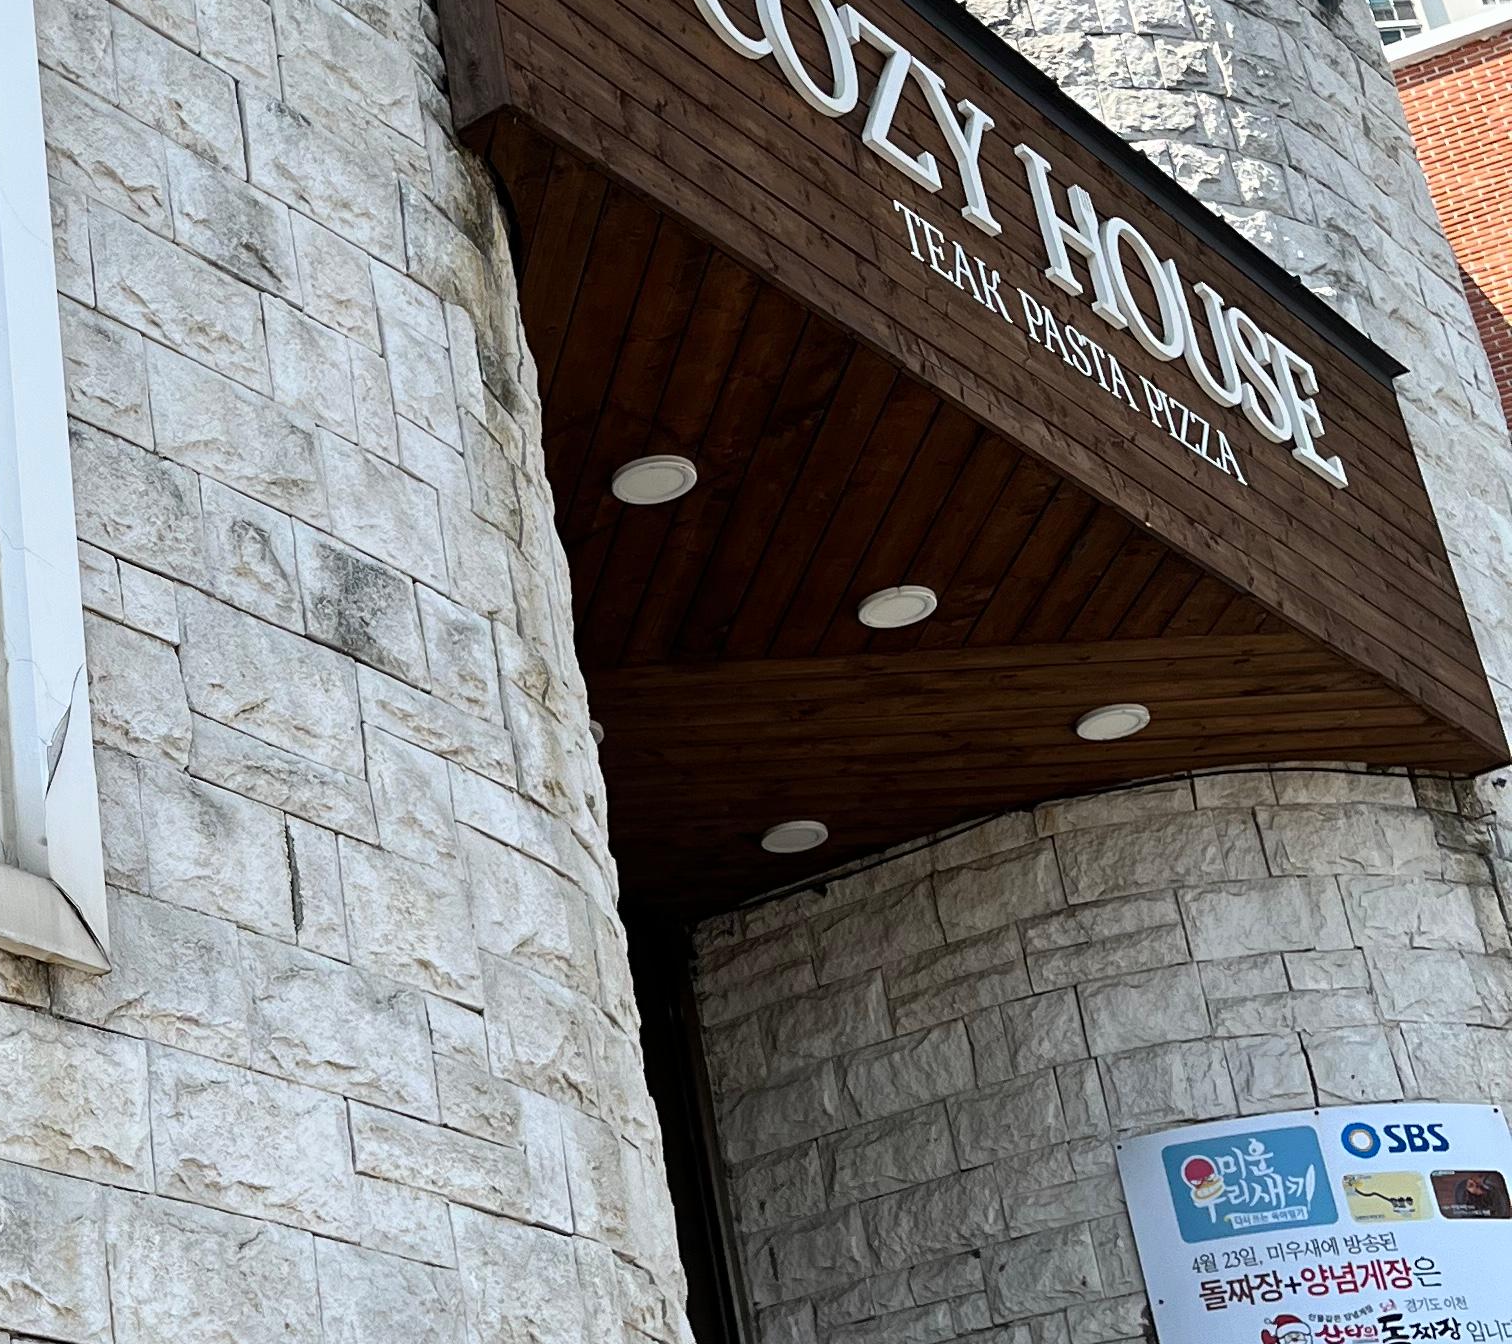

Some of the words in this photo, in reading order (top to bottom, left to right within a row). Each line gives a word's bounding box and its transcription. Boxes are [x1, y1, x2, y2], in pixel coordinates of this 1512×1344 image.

[1014, 143, 1347, 488] HOUSE
[893, 199, 1013, 324] TEAK
[1017, 288, 1141, 412] PASTA
[1138, 375, 1248, 486] PIZZA
[1215, 1138, 1274, 1178] 미운
[1383, 1123, 1450, 1153] SBS
[1192, 1253, 1219, 1274] 4월
[1267, 1239, 1340, 1263] 미우새에
[1344, 1231, 1399, 1255] 방송된
[1404, 1297, 1440, 1313] 경기도
[1443, 1295, 1469, 1311] 이천
